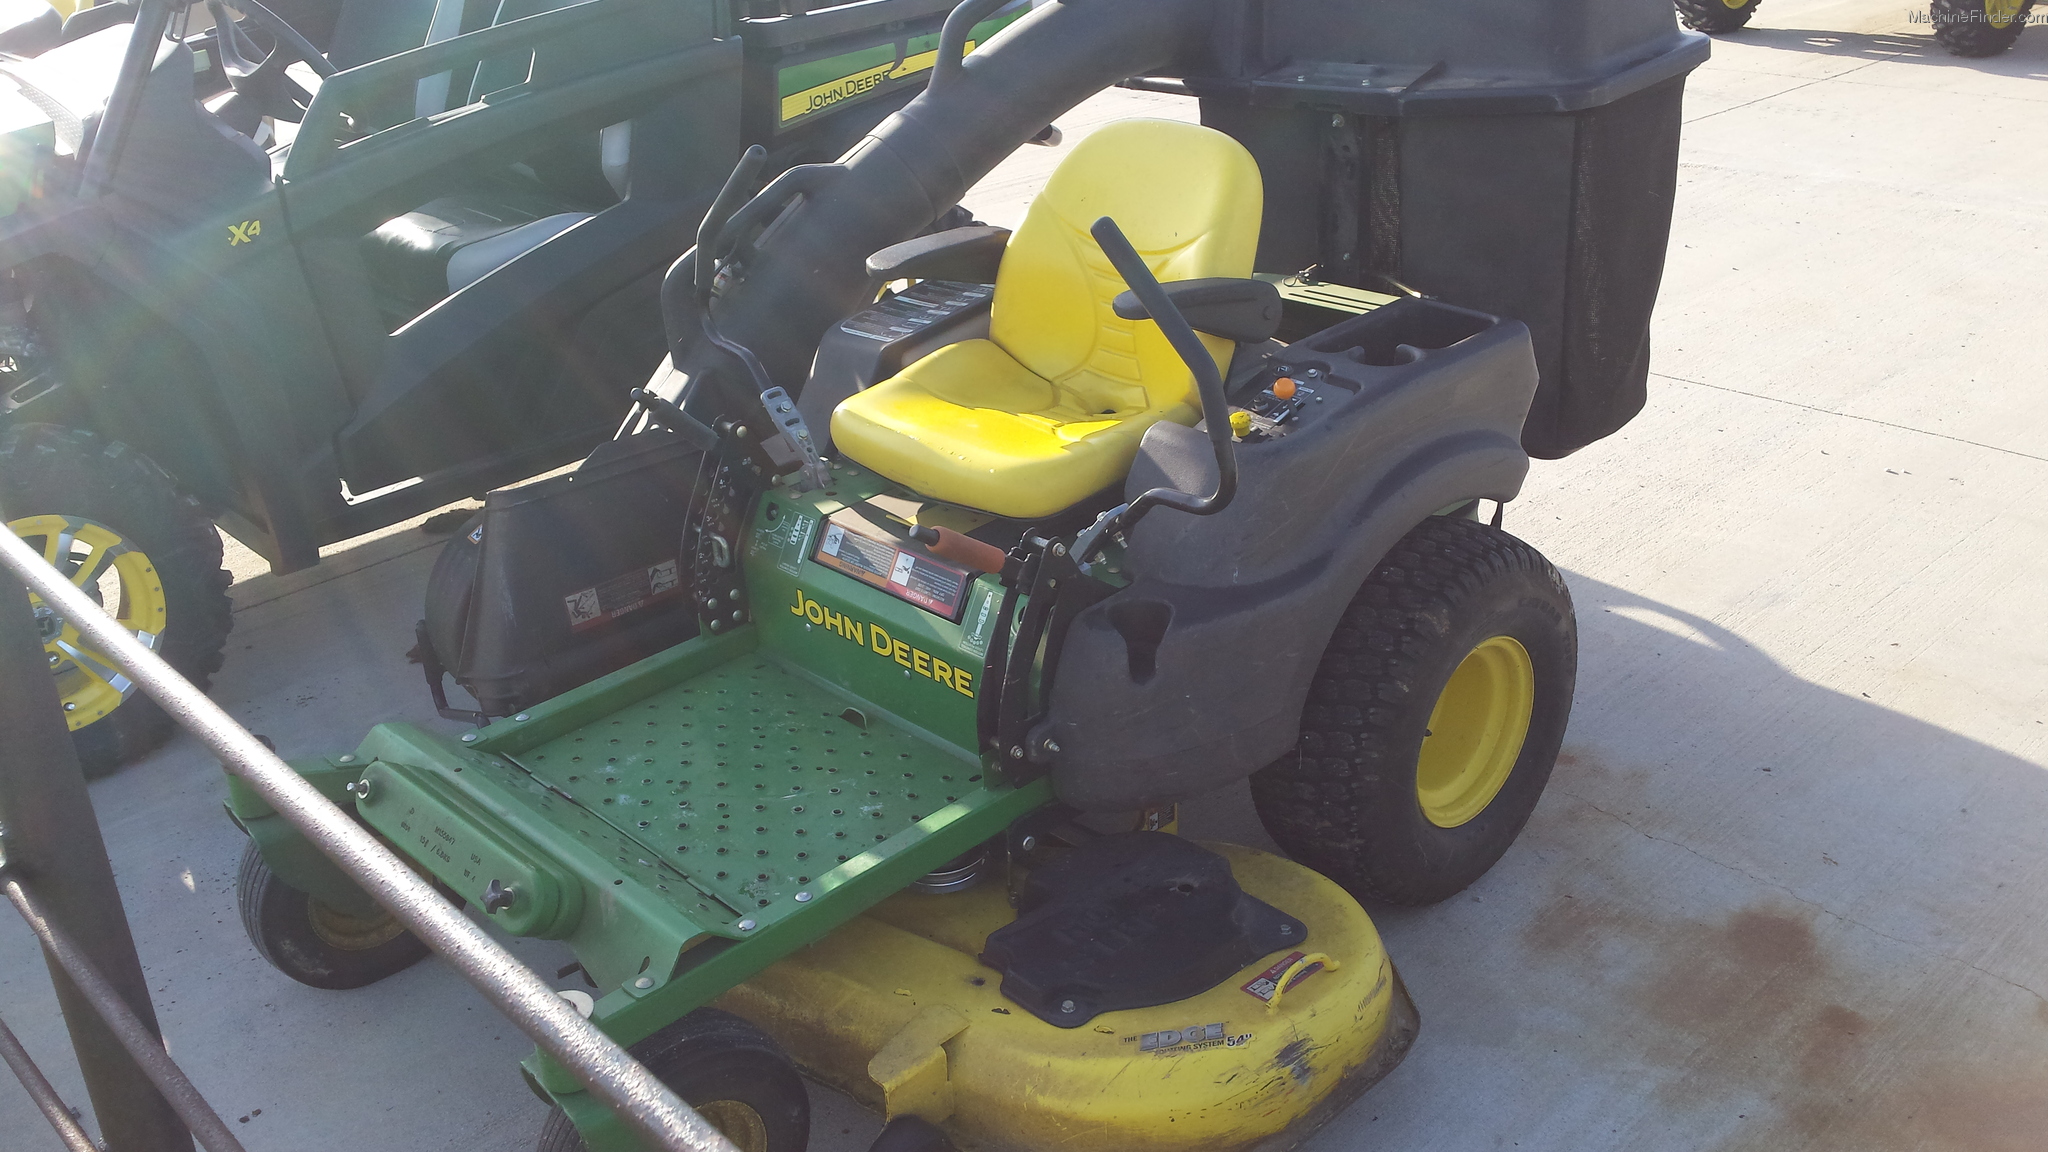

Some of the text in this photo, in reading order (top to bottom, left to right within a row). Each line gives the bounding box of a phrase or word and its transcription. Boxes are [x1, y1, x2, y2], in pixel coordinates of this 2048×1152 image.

[805, 86, 843, 112] JOHN
[227, 219, 261, 247] X4
[790, 588, 975, 699] JOHN DEERE
[1123, 1022, 1225, 1051] THE EDGE
[1193, 1039, 1225, 1051] SYSTEM
